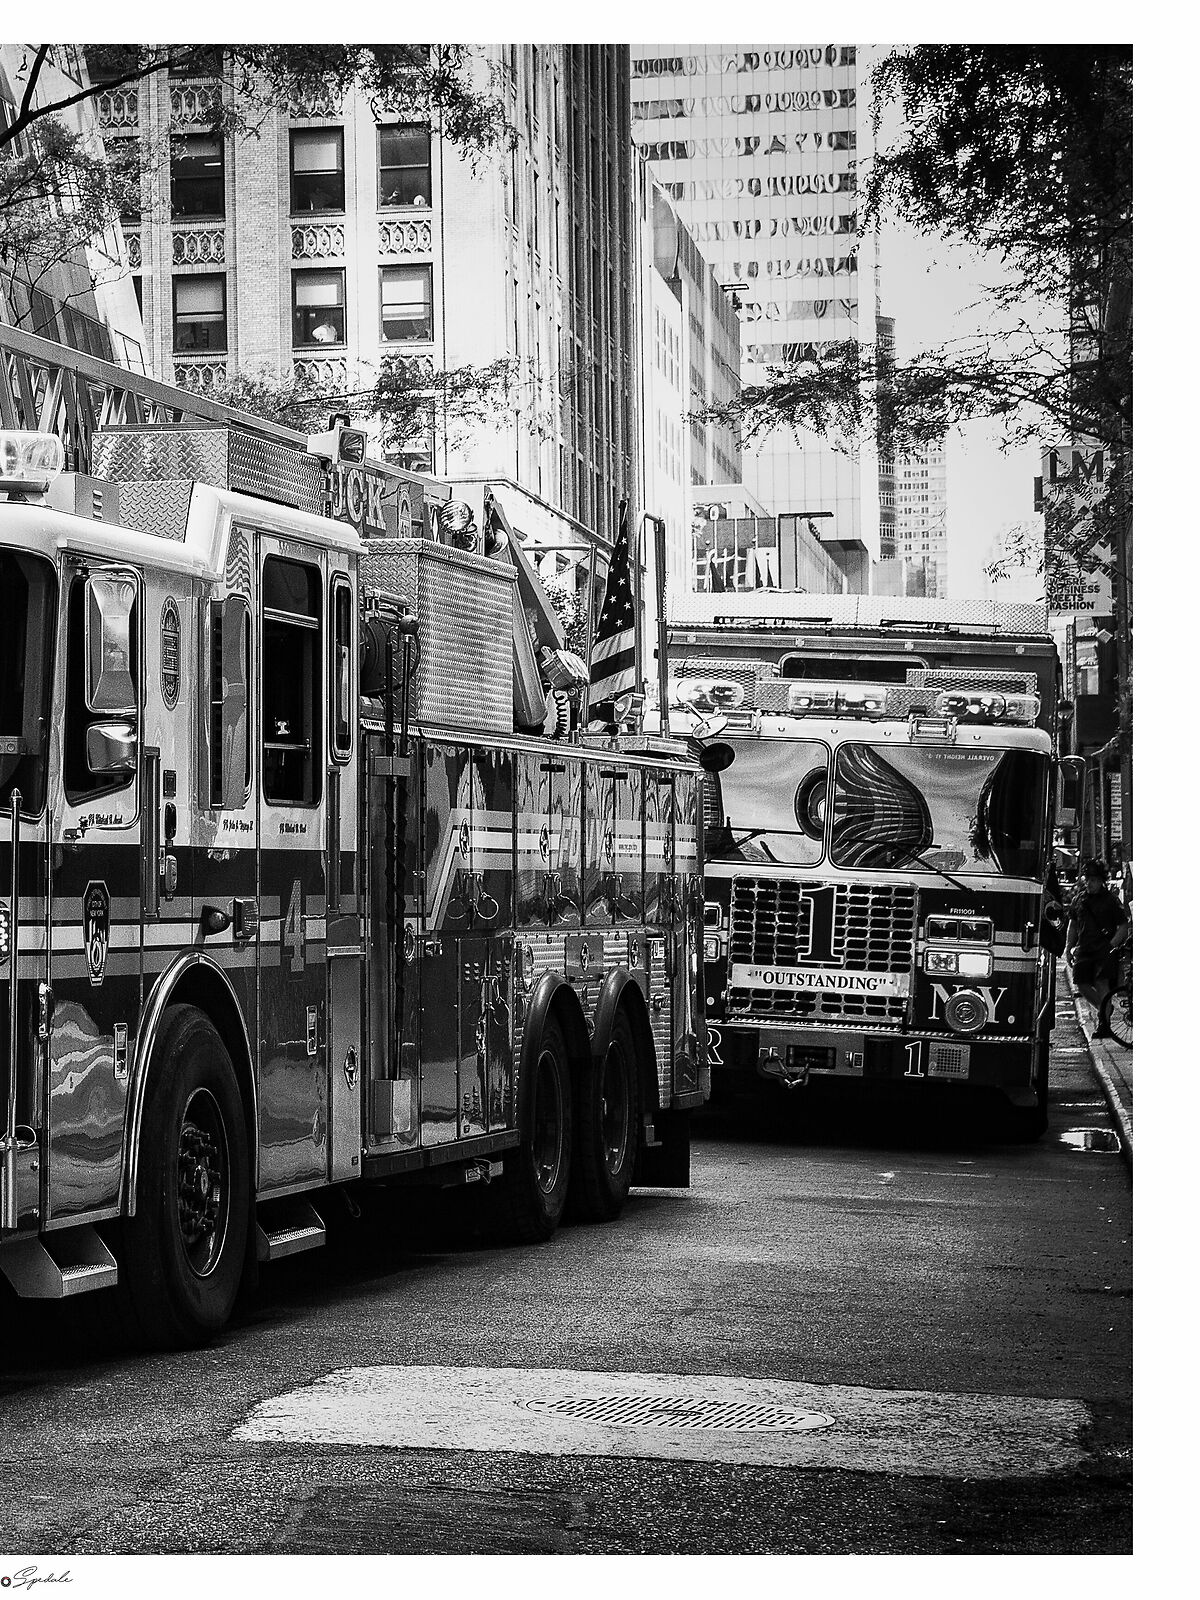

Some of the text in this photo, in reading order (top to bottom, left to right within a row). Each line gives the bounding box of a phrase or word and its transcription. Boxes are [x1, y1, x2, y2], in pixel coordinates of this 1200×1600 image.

[284, 879, 306, 972] 4
[798, 885, 844, 965] 1
[755, 970, 887, 991] "OUTSTANDING"
[904, 1040, 924, 1077] 1
